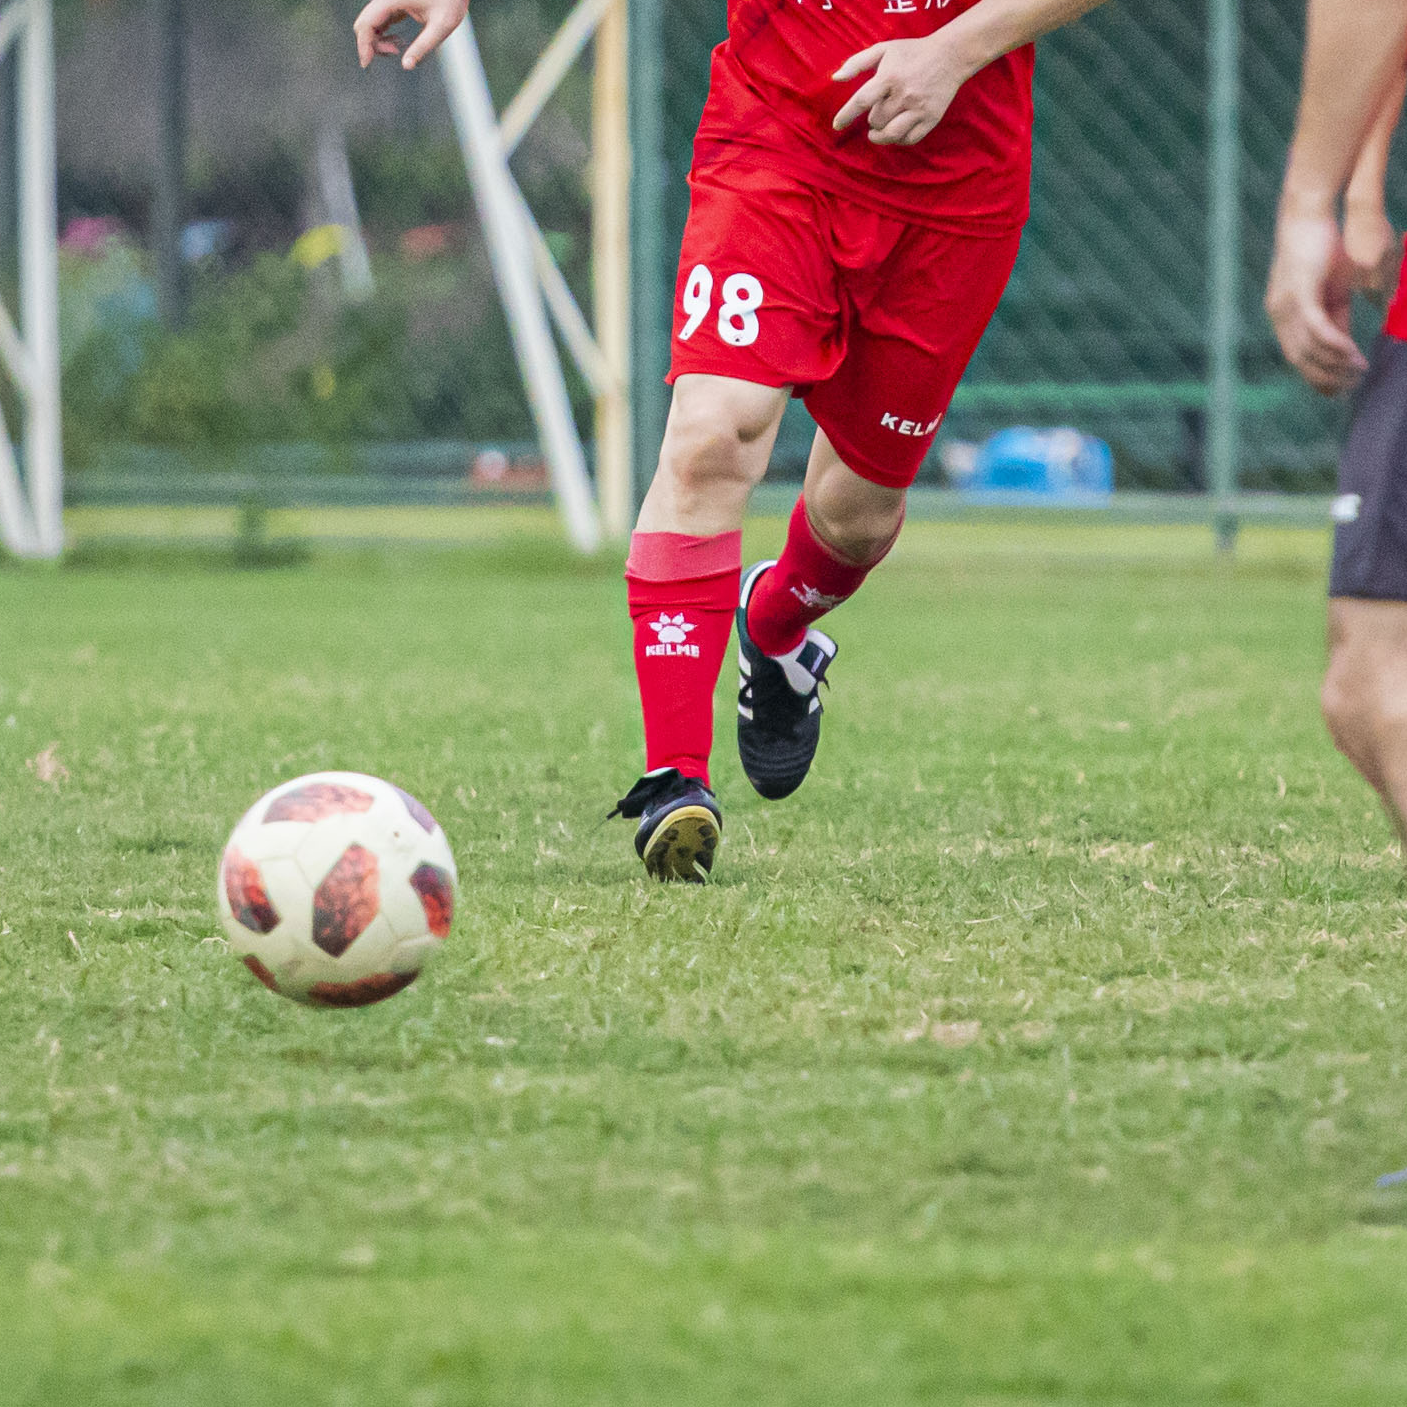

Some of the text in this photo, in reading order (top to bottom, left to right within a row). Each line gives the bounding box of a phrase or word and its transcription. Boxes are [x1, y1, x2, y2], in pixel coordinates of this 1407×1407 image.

[678, 263, 764, 347] 98
[880, 412, 944, 436] KELM
[645, 643, 700, 659] KELME
